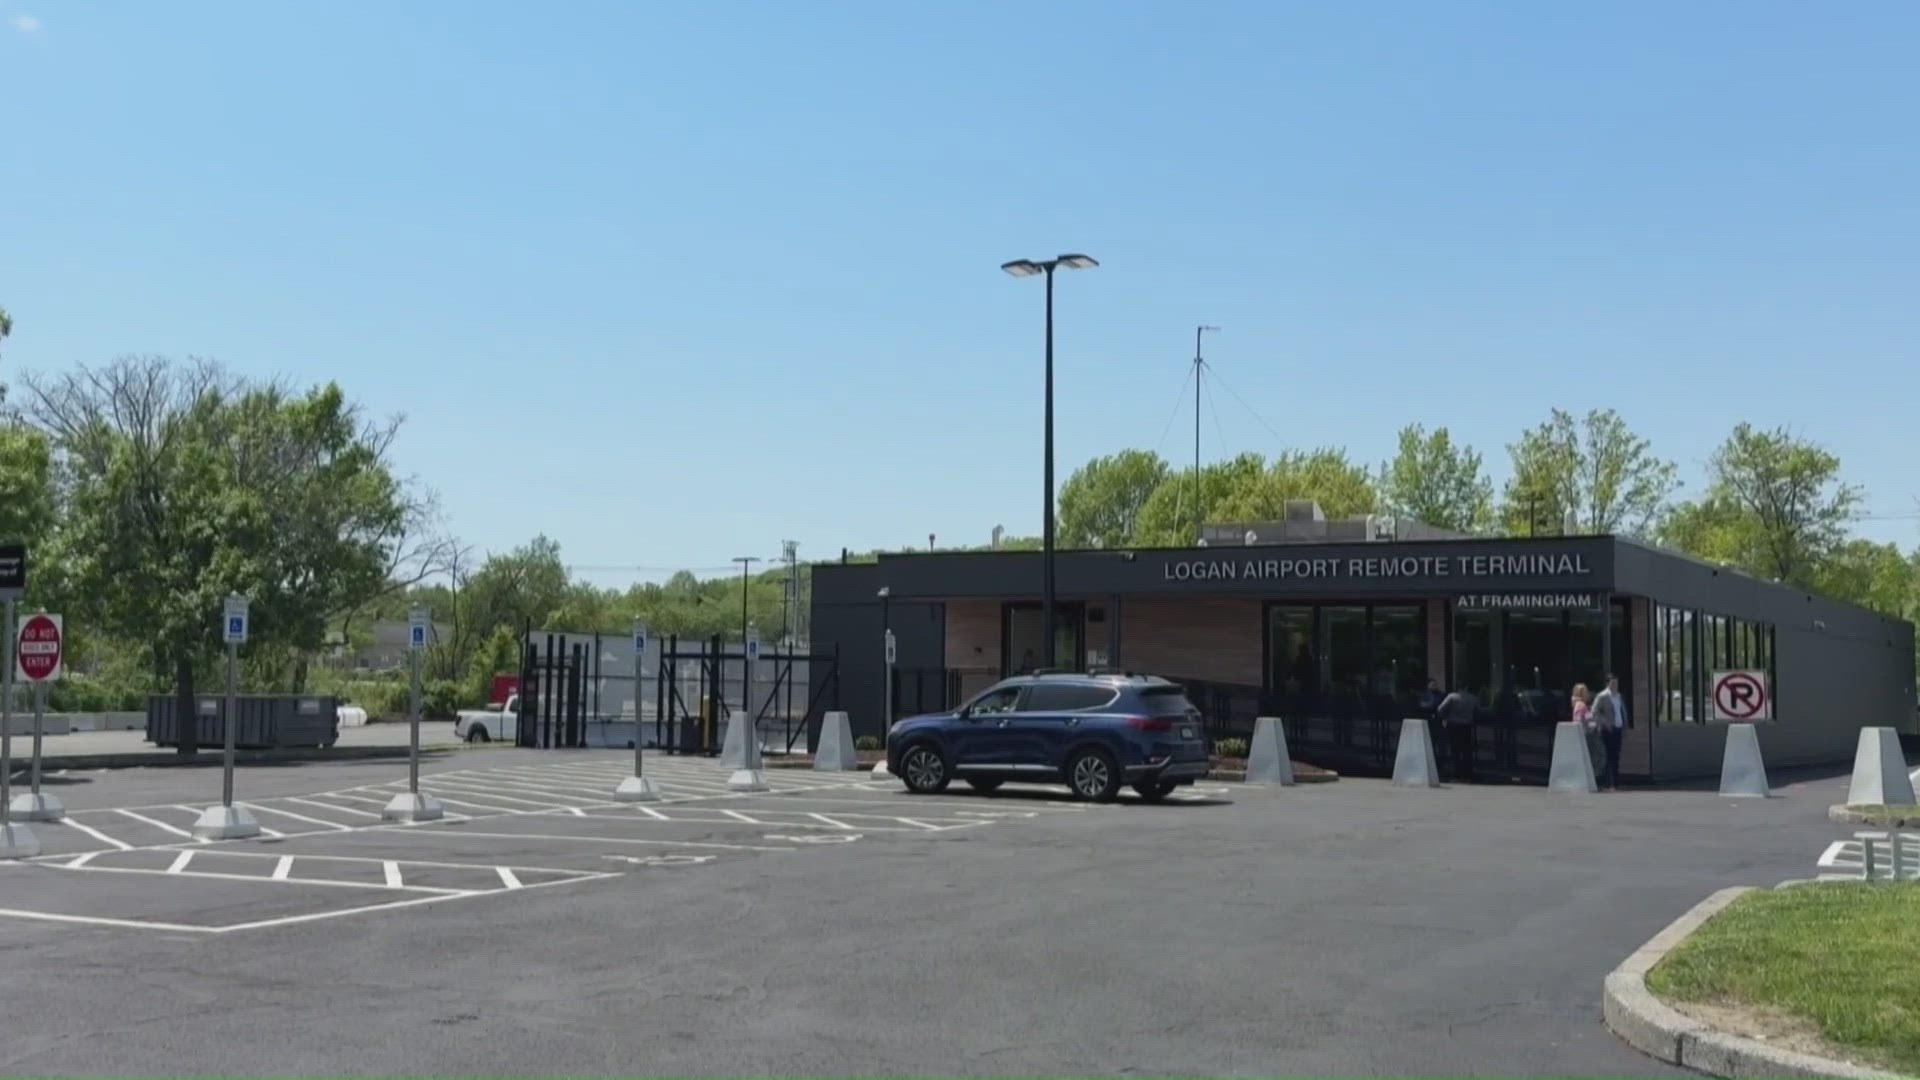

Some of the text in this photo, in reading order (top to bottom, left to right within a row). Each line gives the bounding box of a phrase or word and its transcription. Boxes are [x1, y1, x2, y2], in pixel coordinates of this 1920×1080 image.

[1164, 554, 1590, 580] LOGAN AIRPORT REMOTE TERMINAL
[1457, 594, 1591, 607] AT FRAMINGHAM
[24, 628, 55, 639] DO NOT
[26, 656, 51, 667] ENTER
